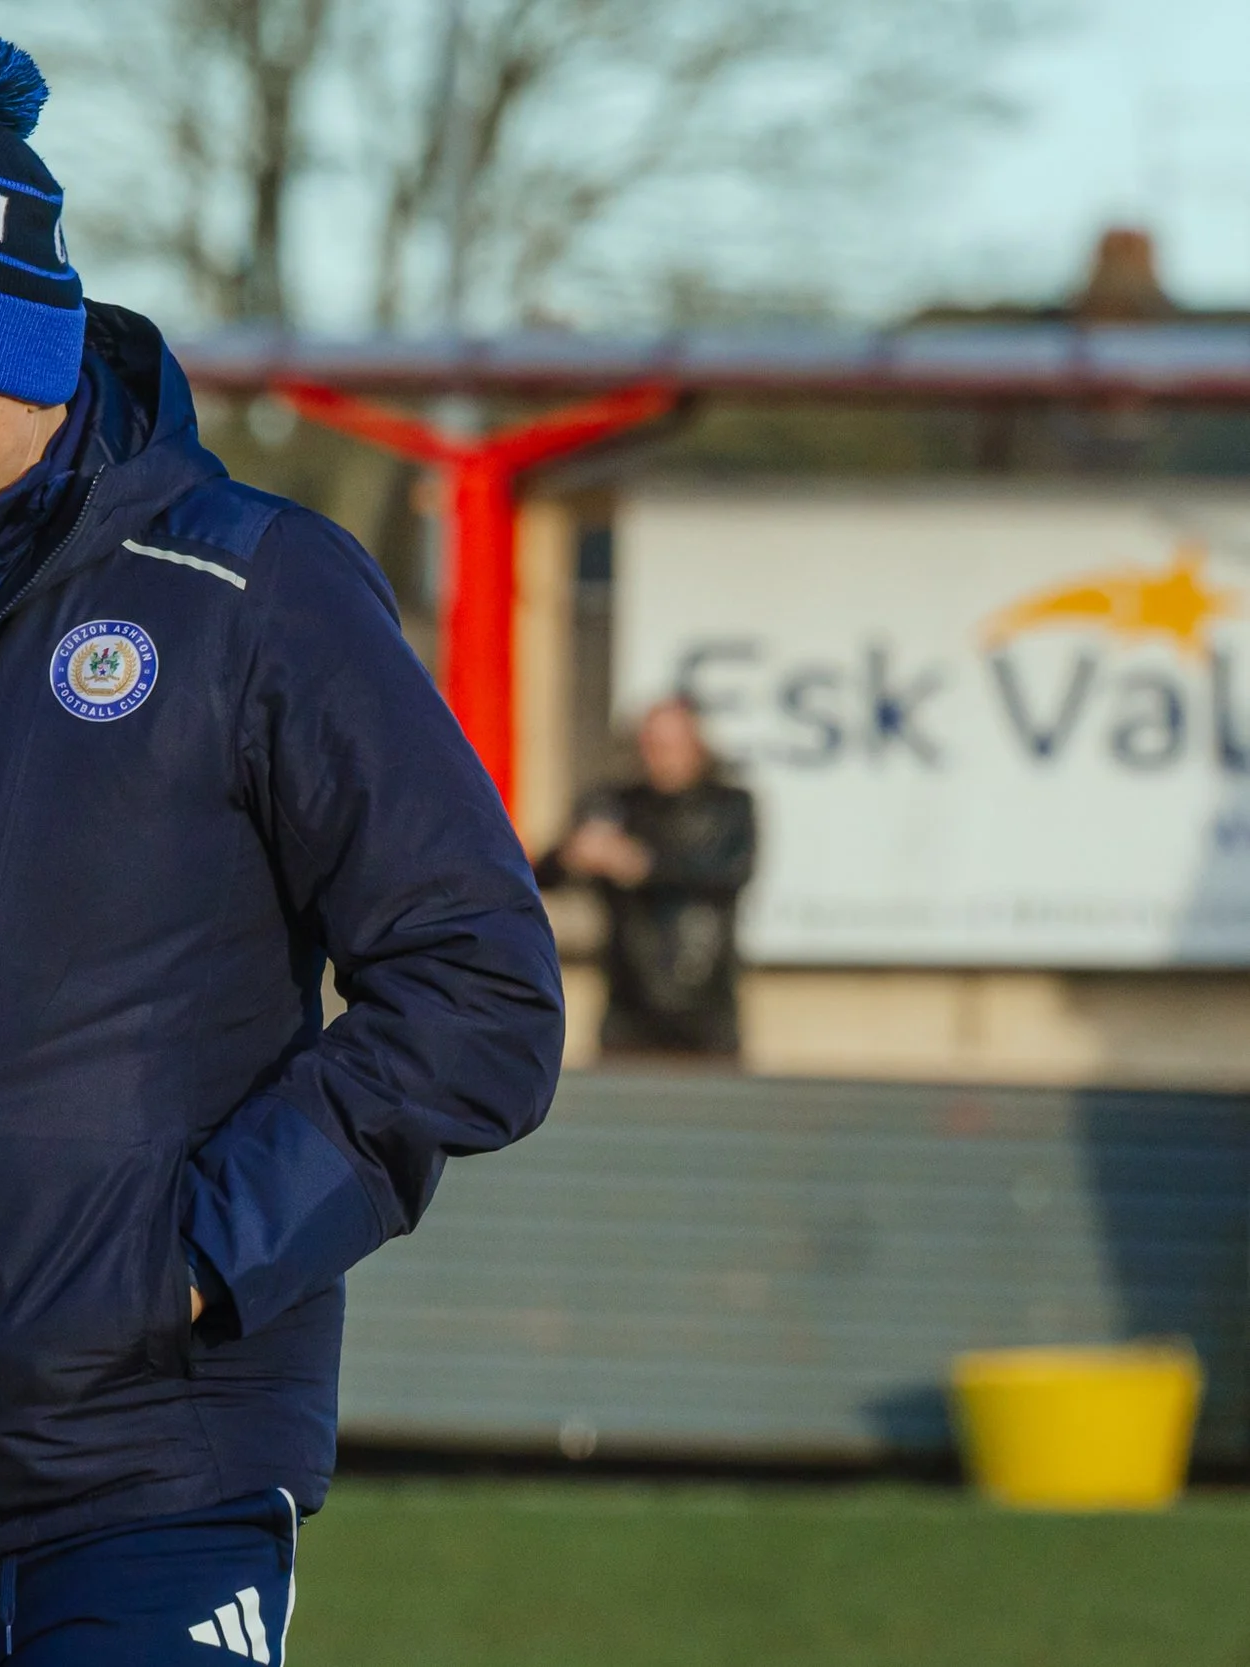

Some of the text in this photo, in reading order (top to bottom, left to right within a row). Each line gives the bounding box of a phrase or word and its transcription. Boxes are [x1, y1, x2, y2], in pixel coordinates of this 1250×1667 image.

[59, 624, 153, 662] CURZON ASHTON
[57, 682, 147, 717] FOOTBALL CLUB
[672, 634, 945, 770] Esk
